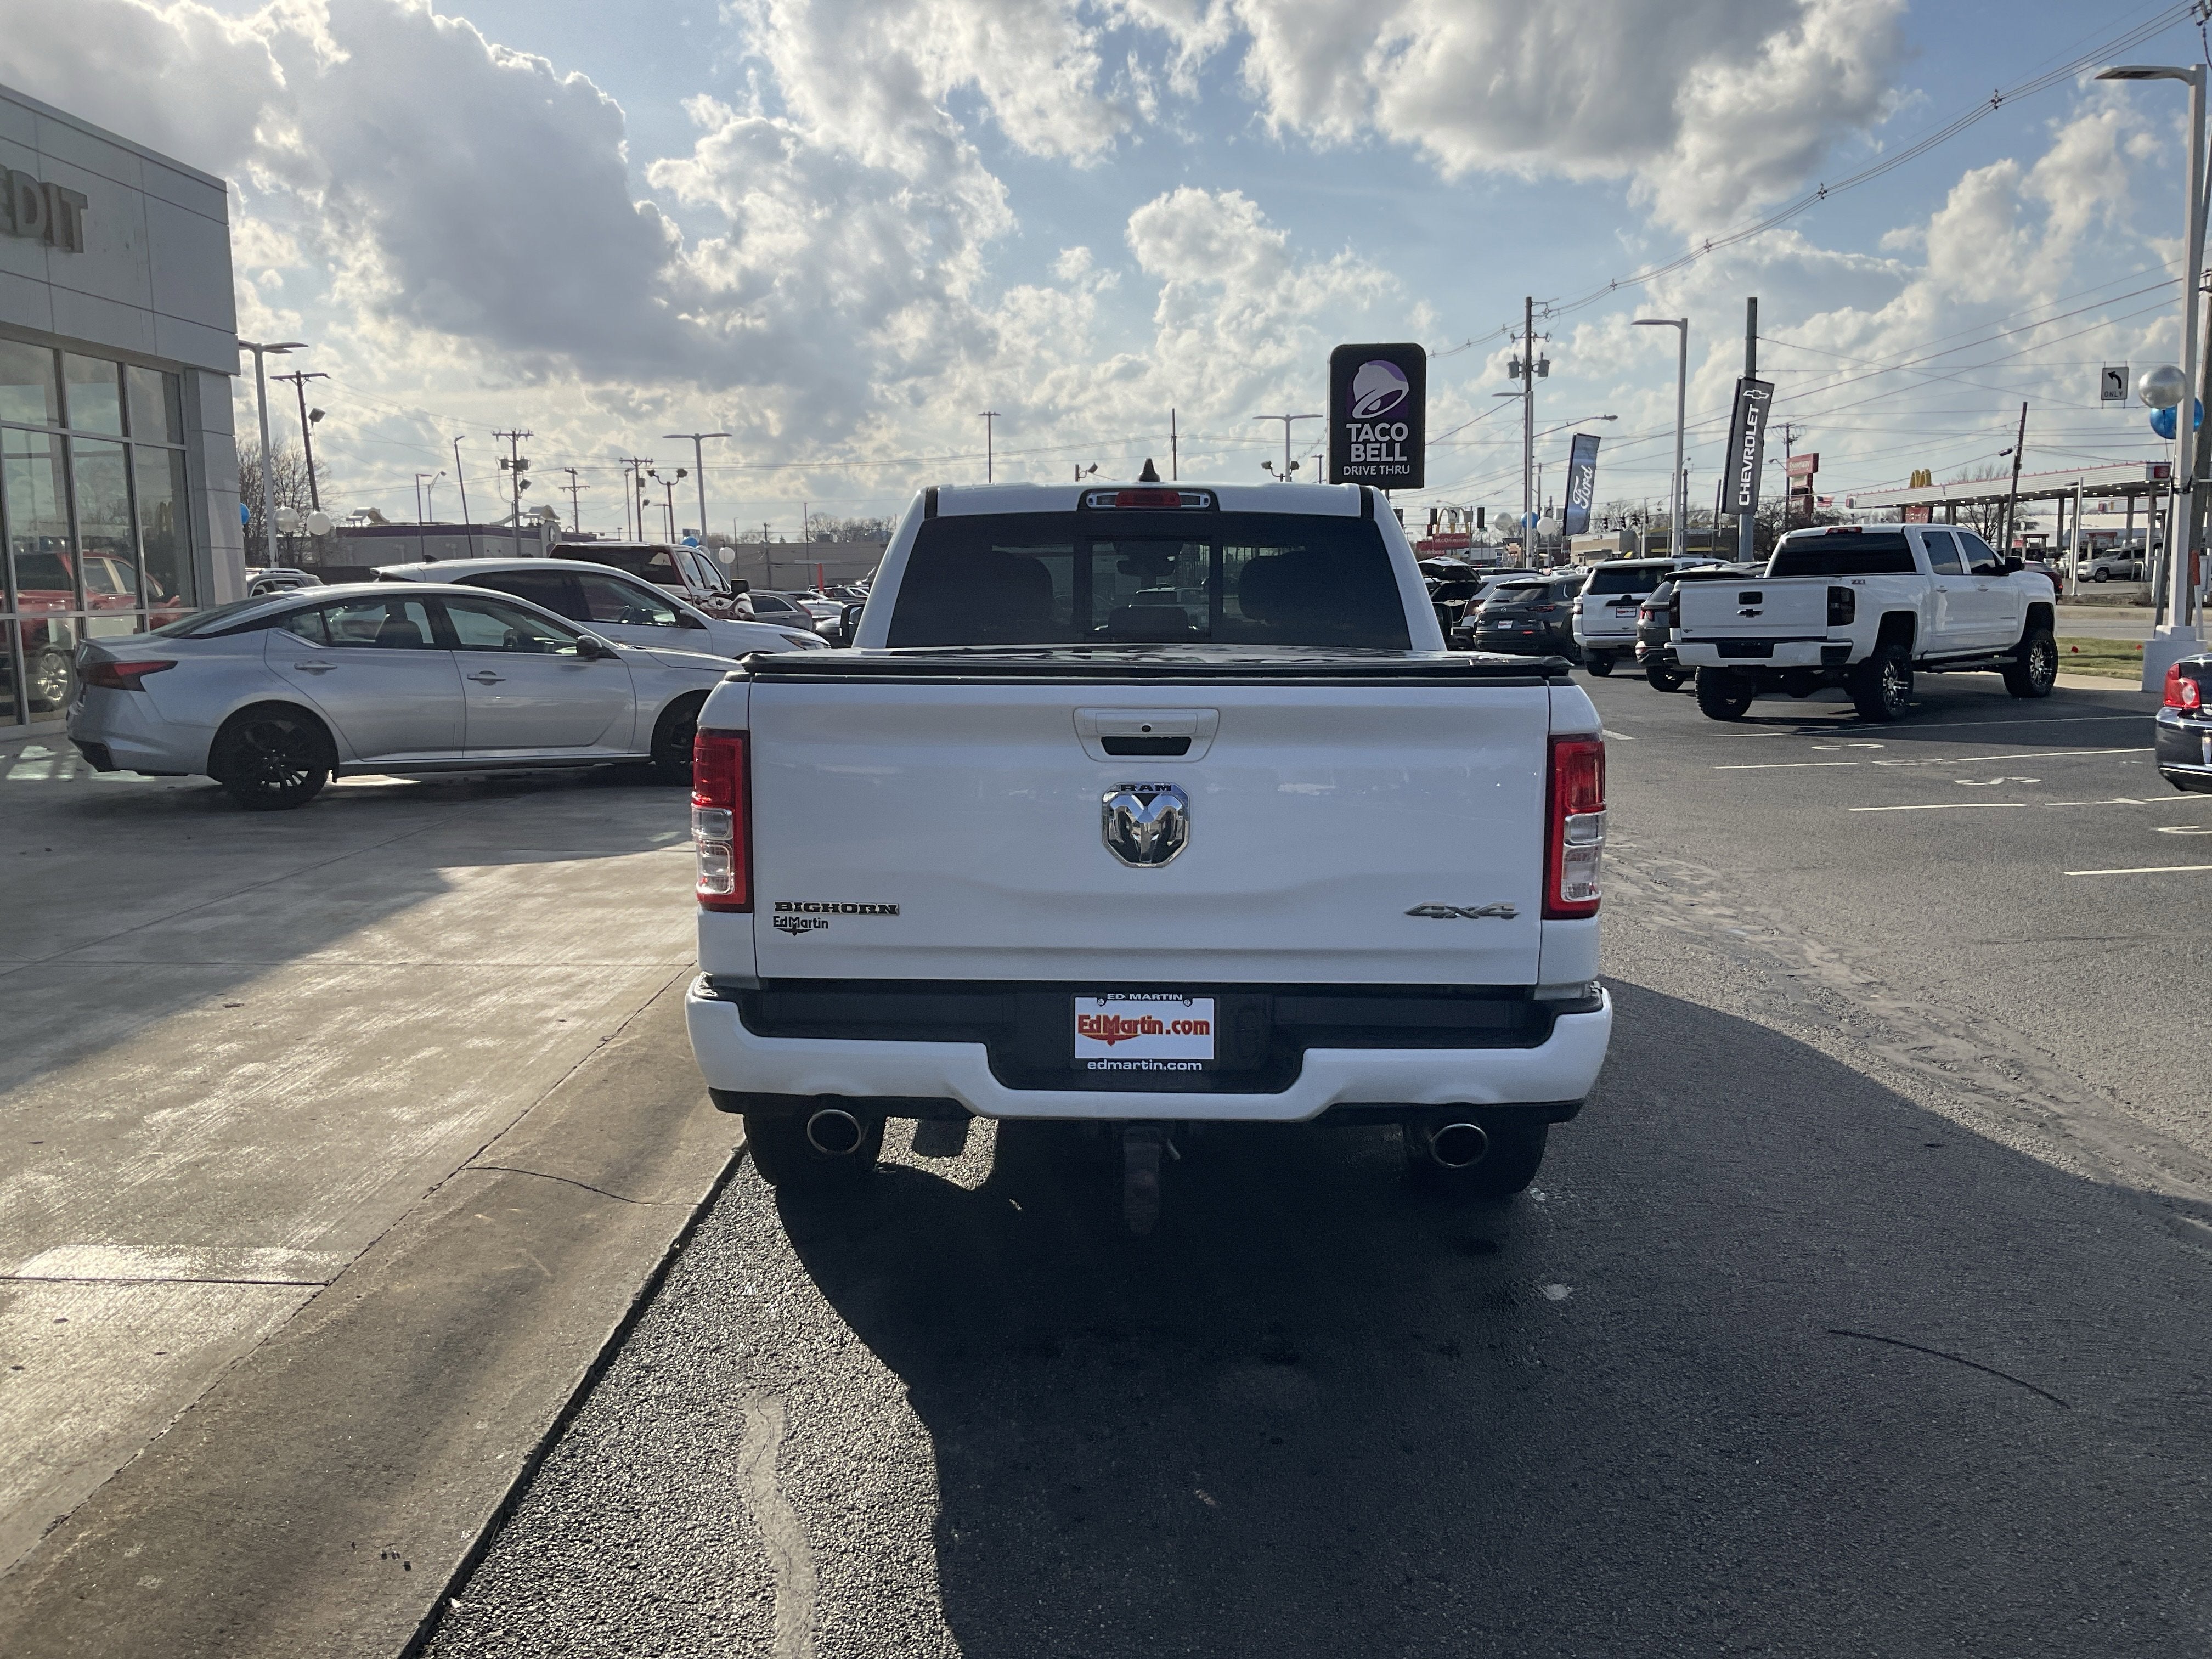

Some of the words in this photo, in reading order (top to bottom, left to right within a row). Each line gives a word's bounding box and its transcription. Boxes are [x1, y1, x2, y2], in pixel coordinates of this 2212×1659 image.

[1346, 422, 1409, 442] TACO
[1351, 443, 1407, 462] BELL
[1739, 404, 1759, 506] CHEVROLET
[1343, 465, 1376, 476] DRIVE
[1379, 465, 1410, 475] THRU
[1573, 465, 1593, 509] Ford
[774, 901, 900, 915] BIGHORN
[1077, 1014, 1210, 1037] EdMartin.com
[1087, 1059, 1203, 1070] edmartin.com
